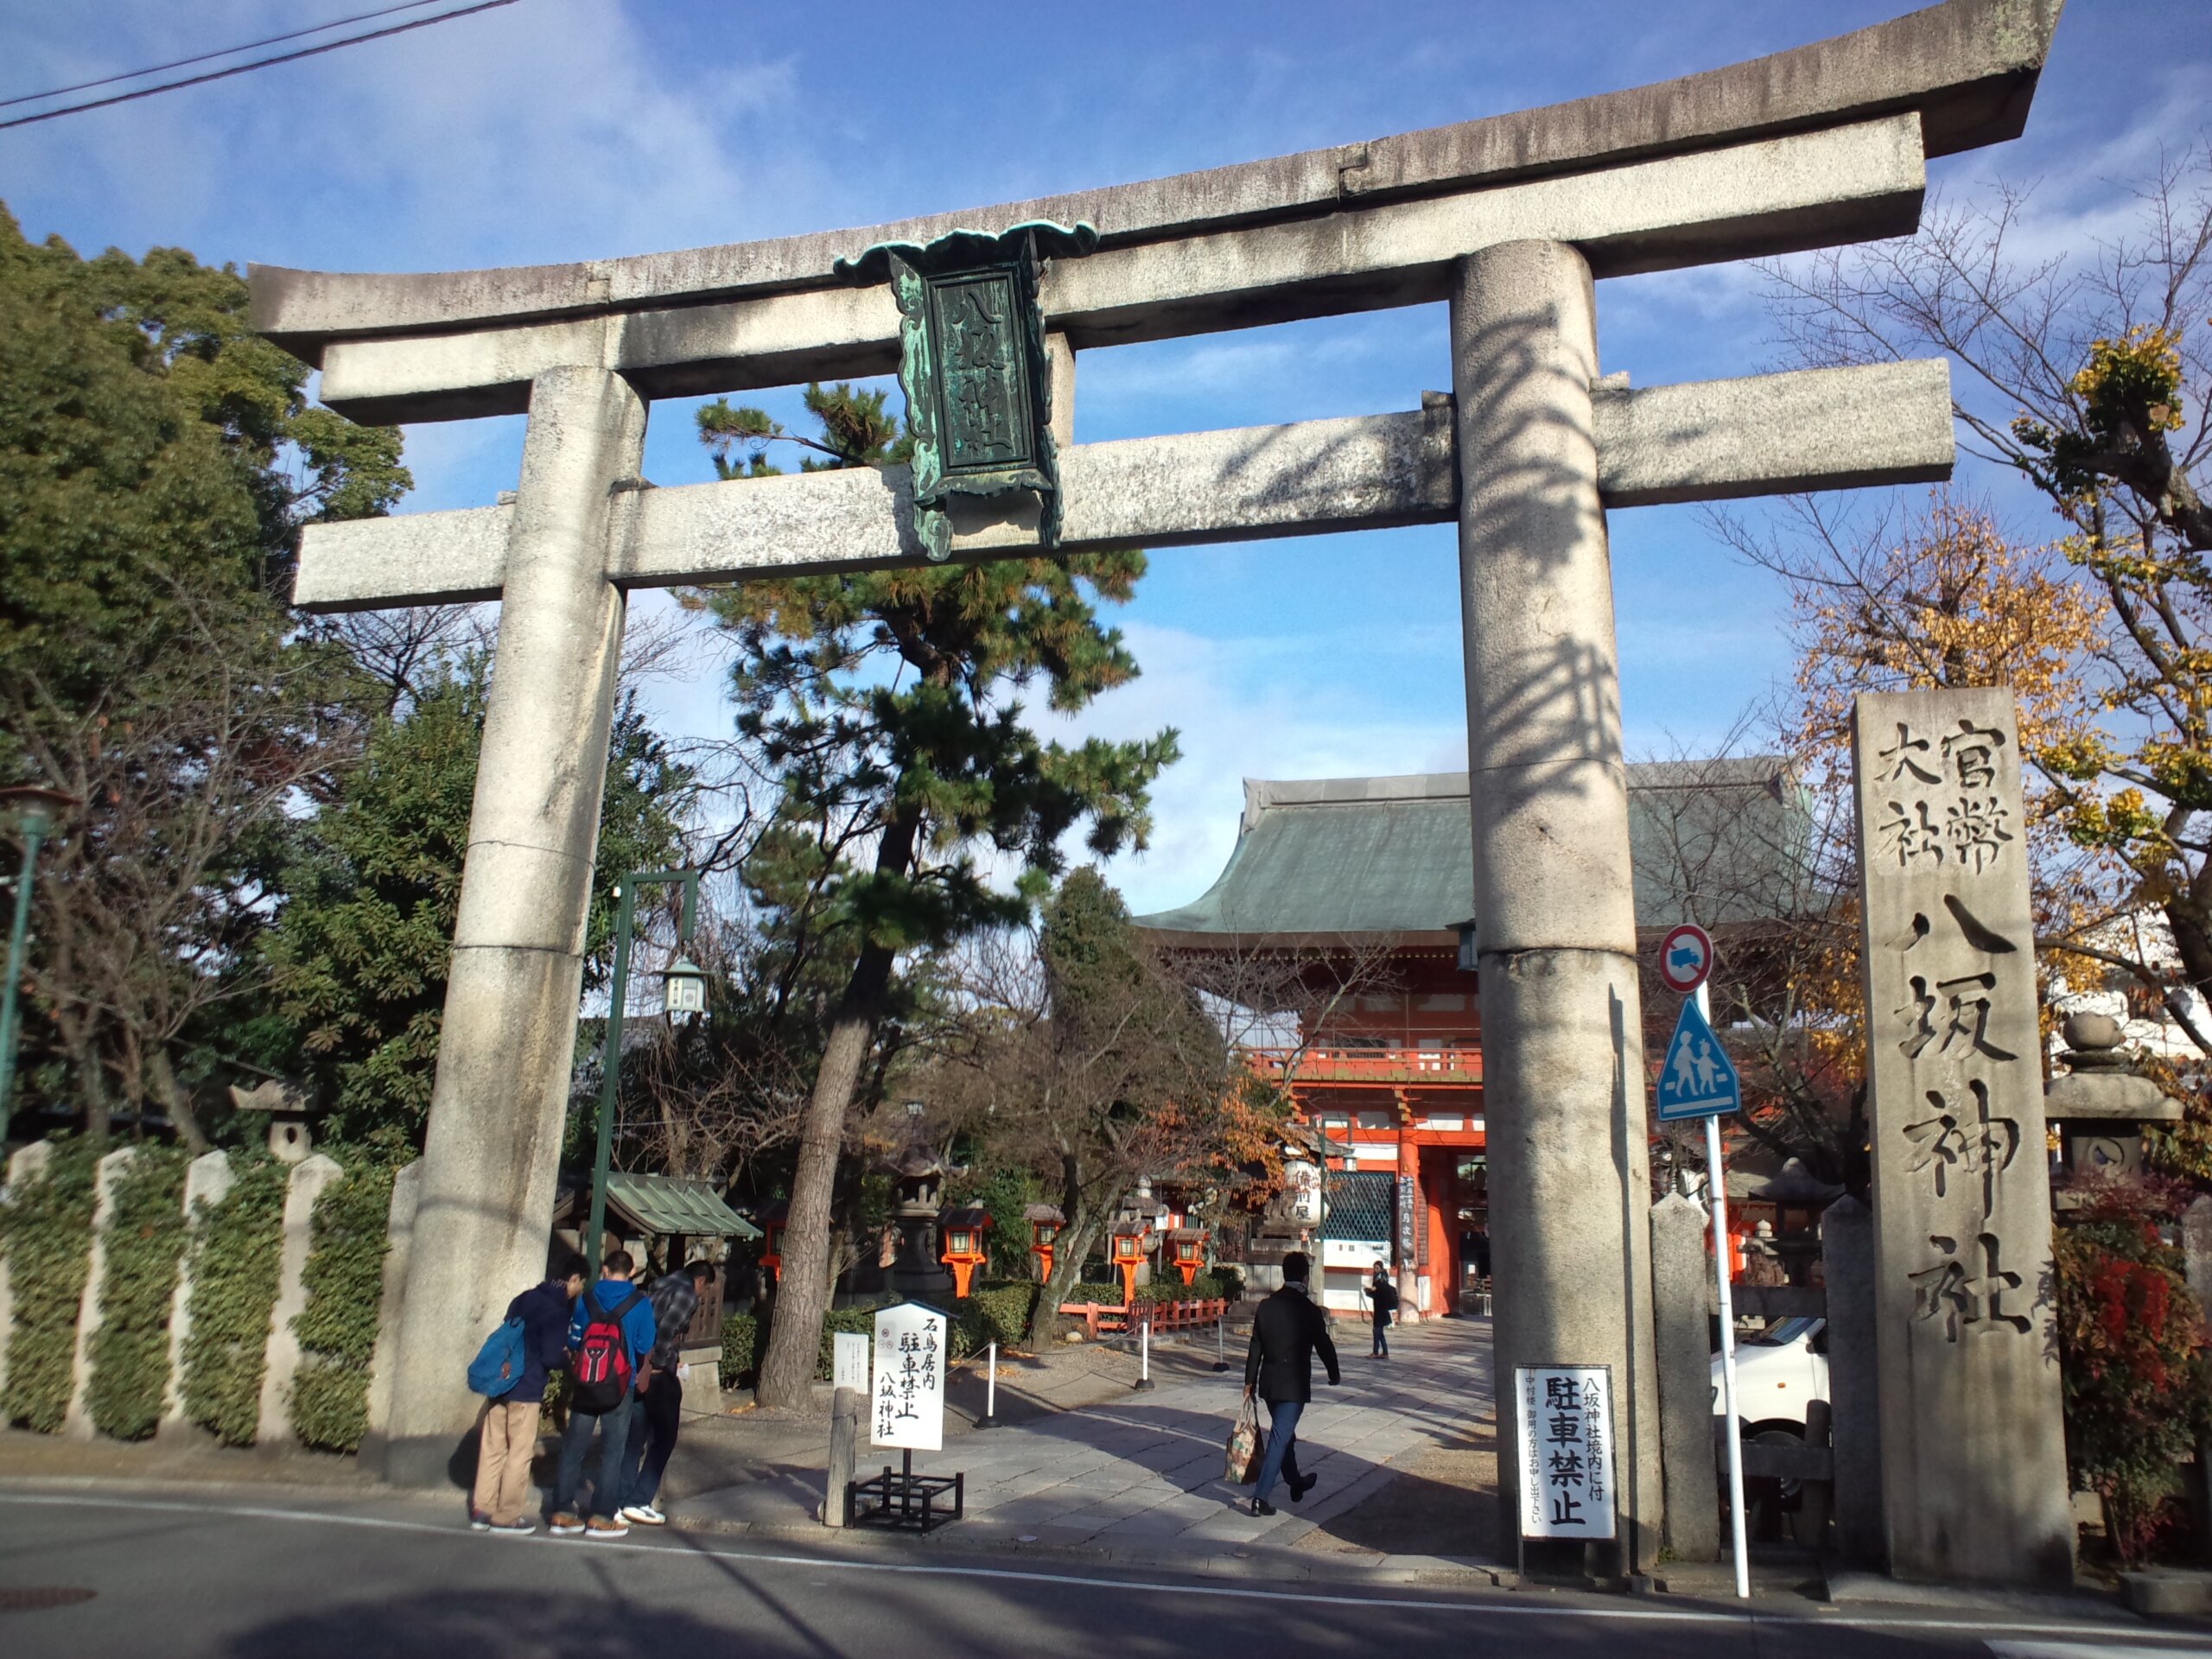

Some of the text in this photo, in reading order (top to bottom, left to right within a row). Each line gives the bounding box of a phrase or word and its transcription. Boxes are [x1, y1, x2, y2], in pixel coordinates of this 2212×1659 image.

[951, 290, 1013, 451] 八坂神社
[1875, 722, 1943, 867] 大社
[1941, 719, 2013, 875] 官幣
[1884, 893, 2032, 1343] 八坂神社
[877, 1371, 897, 1438] 八坂神社
[894, 1332, 922, 1420] 駐車禁止
[921, 1318, 938, 1390] 石鳥居内
[1545, 1376, 1586, 1526] 駐車禁止
[1583, 1377, 1605, 1502] 八坂神社境内に付
